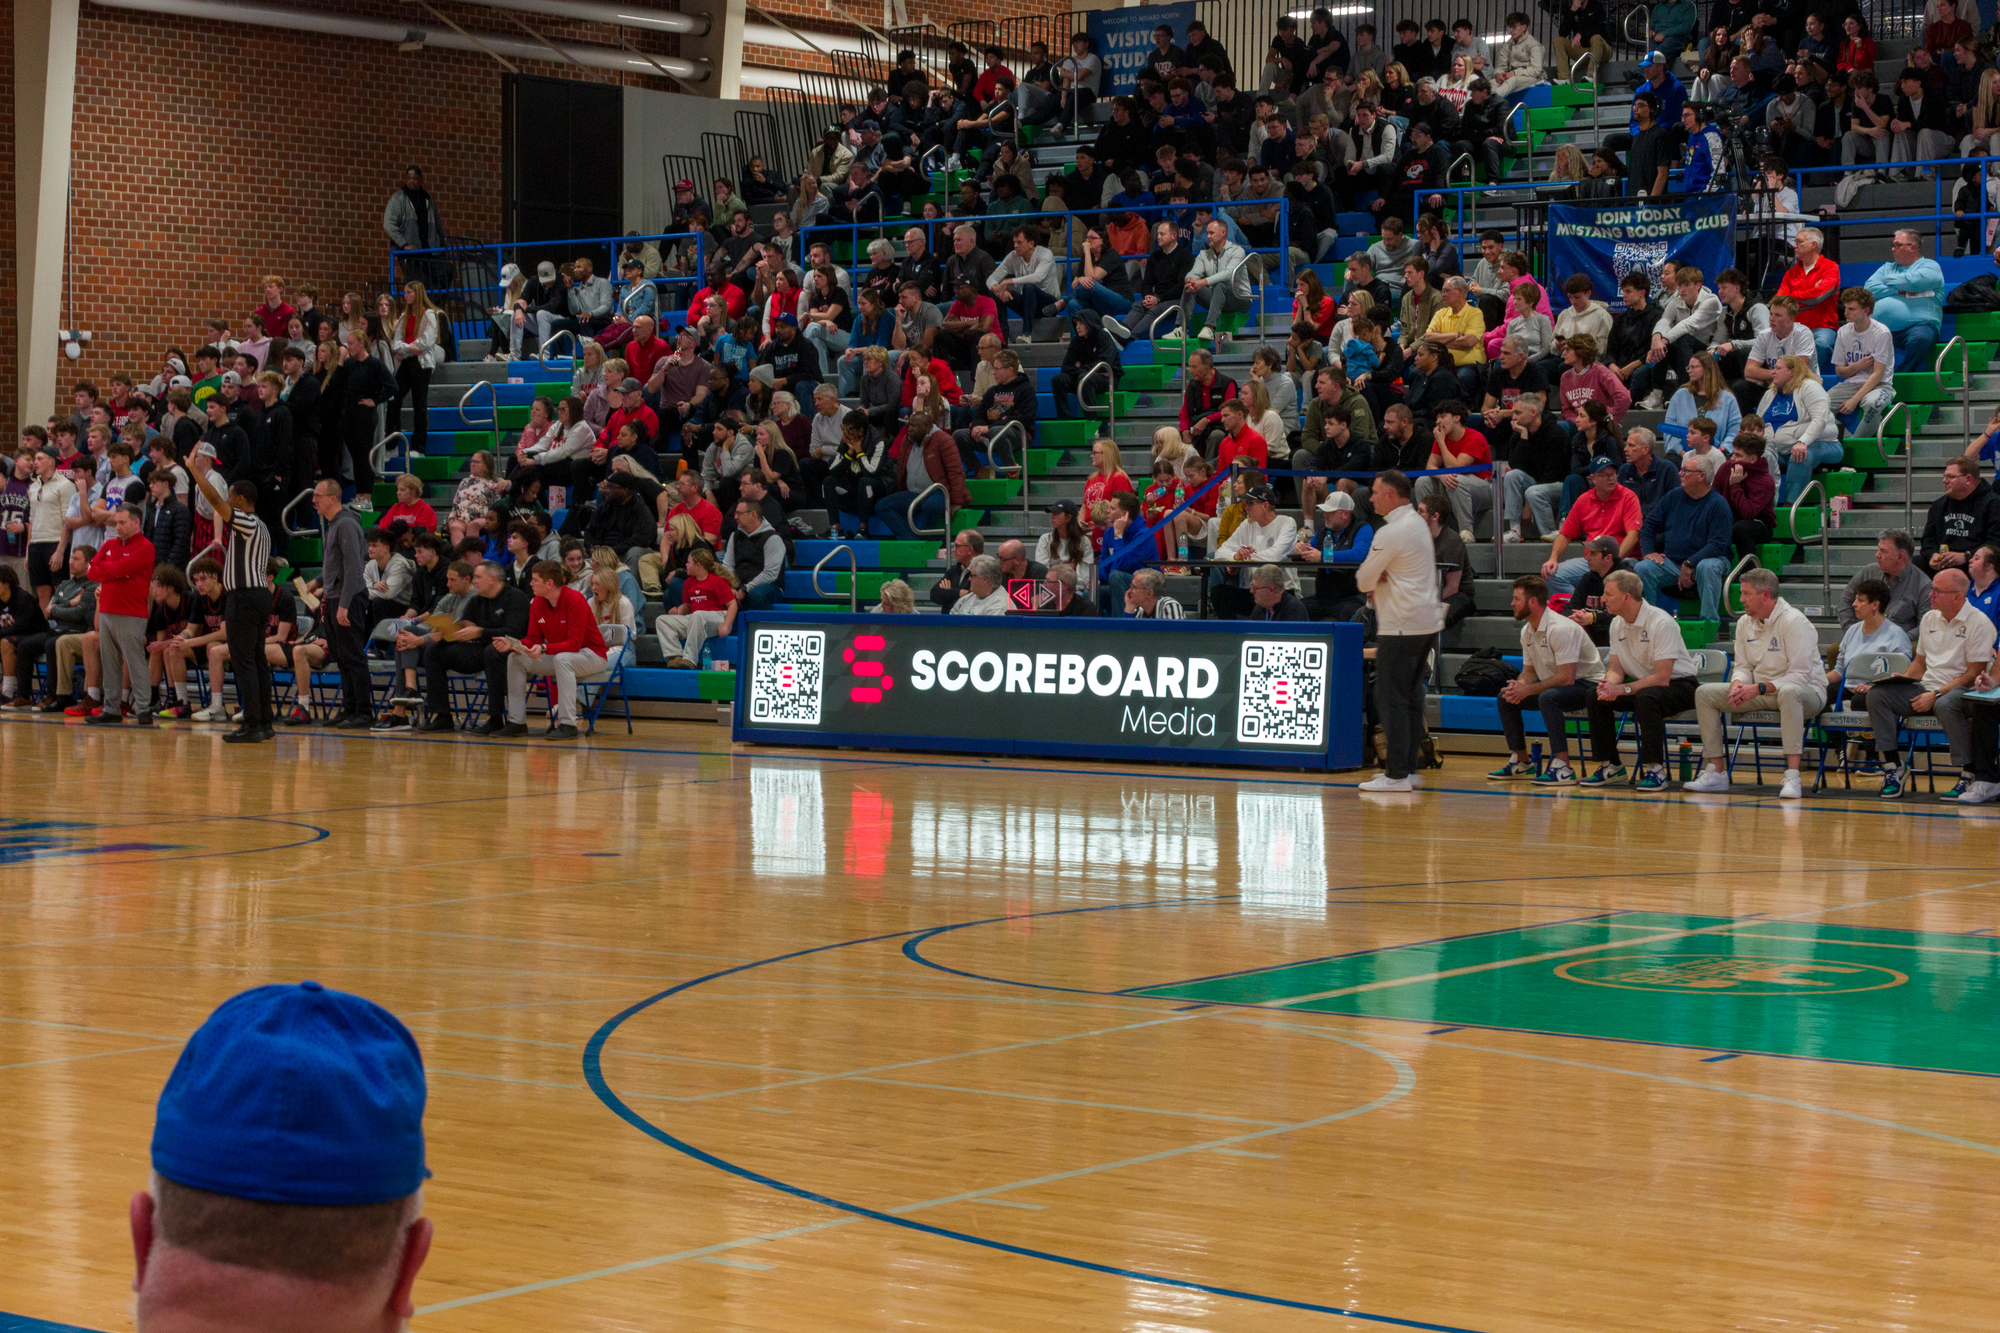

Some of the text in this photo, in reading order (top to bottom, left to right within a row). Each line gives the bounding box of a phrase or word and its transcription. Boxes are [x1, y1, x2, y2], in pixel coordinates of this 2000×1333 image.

[1102, 17, 1128, 25] WELCOME
[1138, 13, 1160, 22] MILLARD
[1161, 11, 1180, 20] NORTH
[1103, 51, 1149, 70] STUD
[1113, 73, 1138, 86] SEA
[1595, 207, 1681, 225] JOIN TODAY
[1556, 214, 1730, 239] MUSTANG BOOSTER CLUB
[0, 495, 29, 509] CARTER
[1, 510, 24, 529] 15
[911, 650, 1219, 699] SCOREBOARD
[1120, 705, 1217, 736] Media
[1739, 712, 1772, 721] MUSTANGS
[1829, 716, 1863, 725] MUSTANGS
